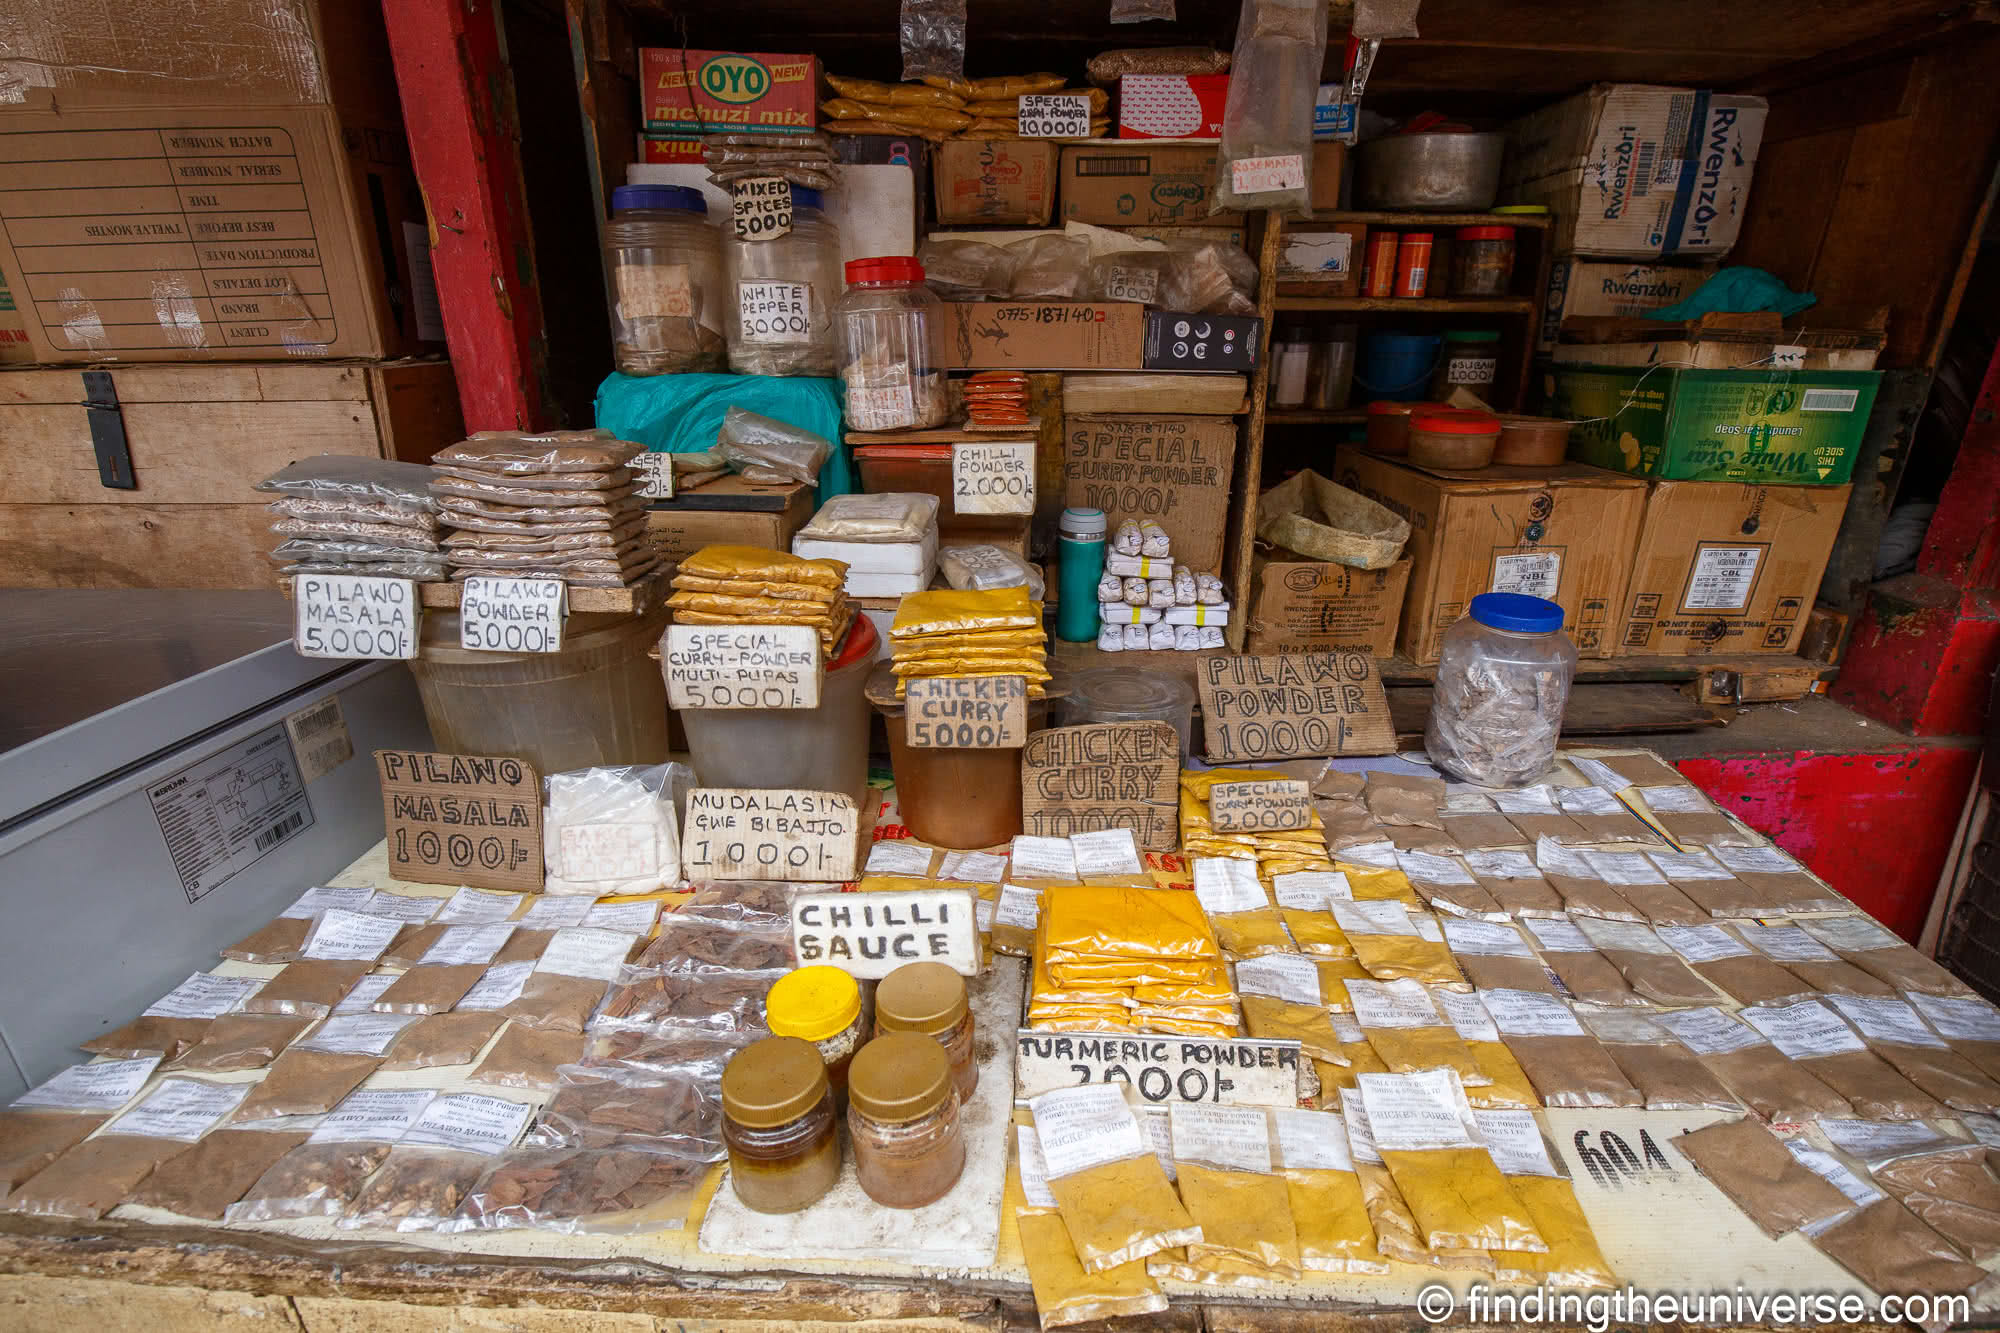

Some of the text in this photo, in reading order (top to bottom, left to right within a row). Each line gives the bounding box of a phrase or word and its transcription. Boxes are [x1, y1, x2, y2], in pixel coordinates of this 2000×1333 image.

[706, 64, 764, 94] OYO
[774, 65, 808, 78] NEW!
[1025, 96, 1084, 108] SPECIAL
[654, 104, 809, 126] mchuzi mix
[170, 135, 273, 150] BATCH NUMBER
[179, 163, 282, 178] SERIAL NUMBER
[734, 181, 789, 197] MIXED
[188, 195, 221, 208] TIME
[734, 197, 792, 216] SPICES
[84, 222, 184, 237] TWELVE MONTHS
[195, 220, 276, 234] BEST BEFORE
[205, 247, 316, 262] PRODUCTION DATE
[212, 277, 289, 290] LOT DETAILS
[742, 286, 804, 300] WHITE
[1601, 278, 1683, 298] Rwenzori
[220, 303, 260, 314] BRAND
[742, 301, 804, 315] PEPPER
[229, 327, 270, 339] CLIENT
[1714, 423, 1741, 436] Soap
[960, 447, 1016, 460] CHILLI
[1071, 431, 1207, 465] SPECIAL
[1812, 446, 1845, 457] SIDE UP
[959, 460, 1025, 473] POWDER
[1680, 450, 1735, 472] Star
[1816, 456, 1837, 466] THIS
[305, 580, 405, 604] PILAWO
[464, 578, 559, 600] PILAWO
[306, 603, 406, 626] MASALA
[464, 602, 550, 622] POWDER
[689, 633, 787, 653] SPECIAL
[1278, 644, 1289, 653] 10
[1311, 644, 1330, 653] 300
[1333, 643, 1374, 653] Sachets
[1207, 653, 1370, 687] PILAWO
[906, 679, 1026, 698] CHICKEN
[921, 700, 1009, 721] CURRY
[1213, 685, 1370, 717] POWDER
[914, 723, 1011, 748] 5000/=
[1024, 727, 1178, 768] CHICKEN
[383, 752, 522, 786] PILAWO
[1037, 765, 1163, 802] CURRY
[1215, 782, 1300, 799] SPECIAL
[393, 794, 530, 828] MASALA
[690, 793, 848, 814] MUDALASIN
[799, 902, 950, 928] CHILLI
[799, 932, 951, 961] SAUCE
[1018, 1037, 1299, 1070] TURMERIC POWDER
[471, 1096, 496, 1107] CURRY
[1421, 1111, 1456, 1121] CURRY
[420, 1120, 509, 1141] PILAWO MASALA
